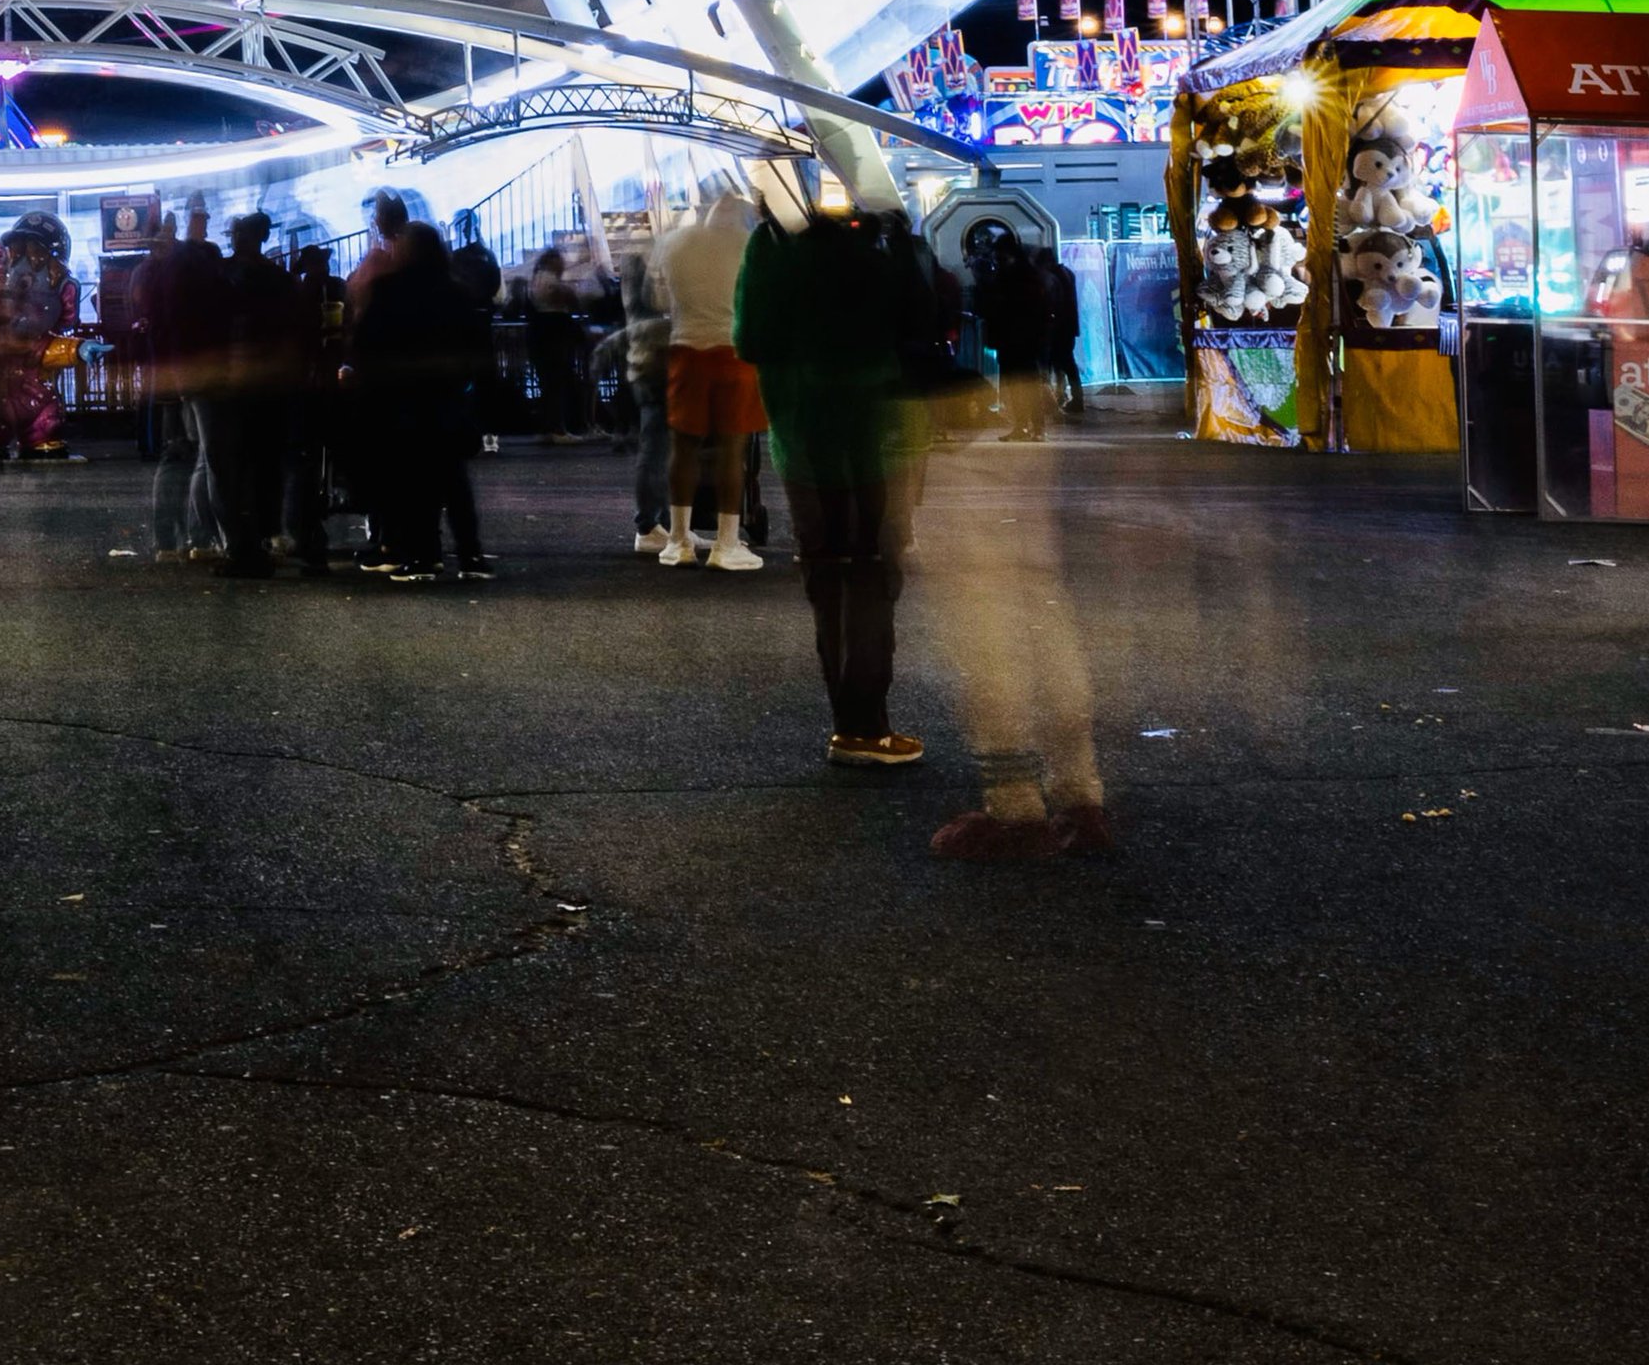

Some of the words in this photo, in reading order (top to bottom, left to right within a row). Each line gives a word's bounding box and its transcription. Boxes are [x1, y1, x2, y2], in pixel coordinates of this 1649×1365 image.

[1567, 63, 1649, 95] AT
[1019, 100, 1095, 127] WIN
[1126, 252, 1157, 270] NORTH
